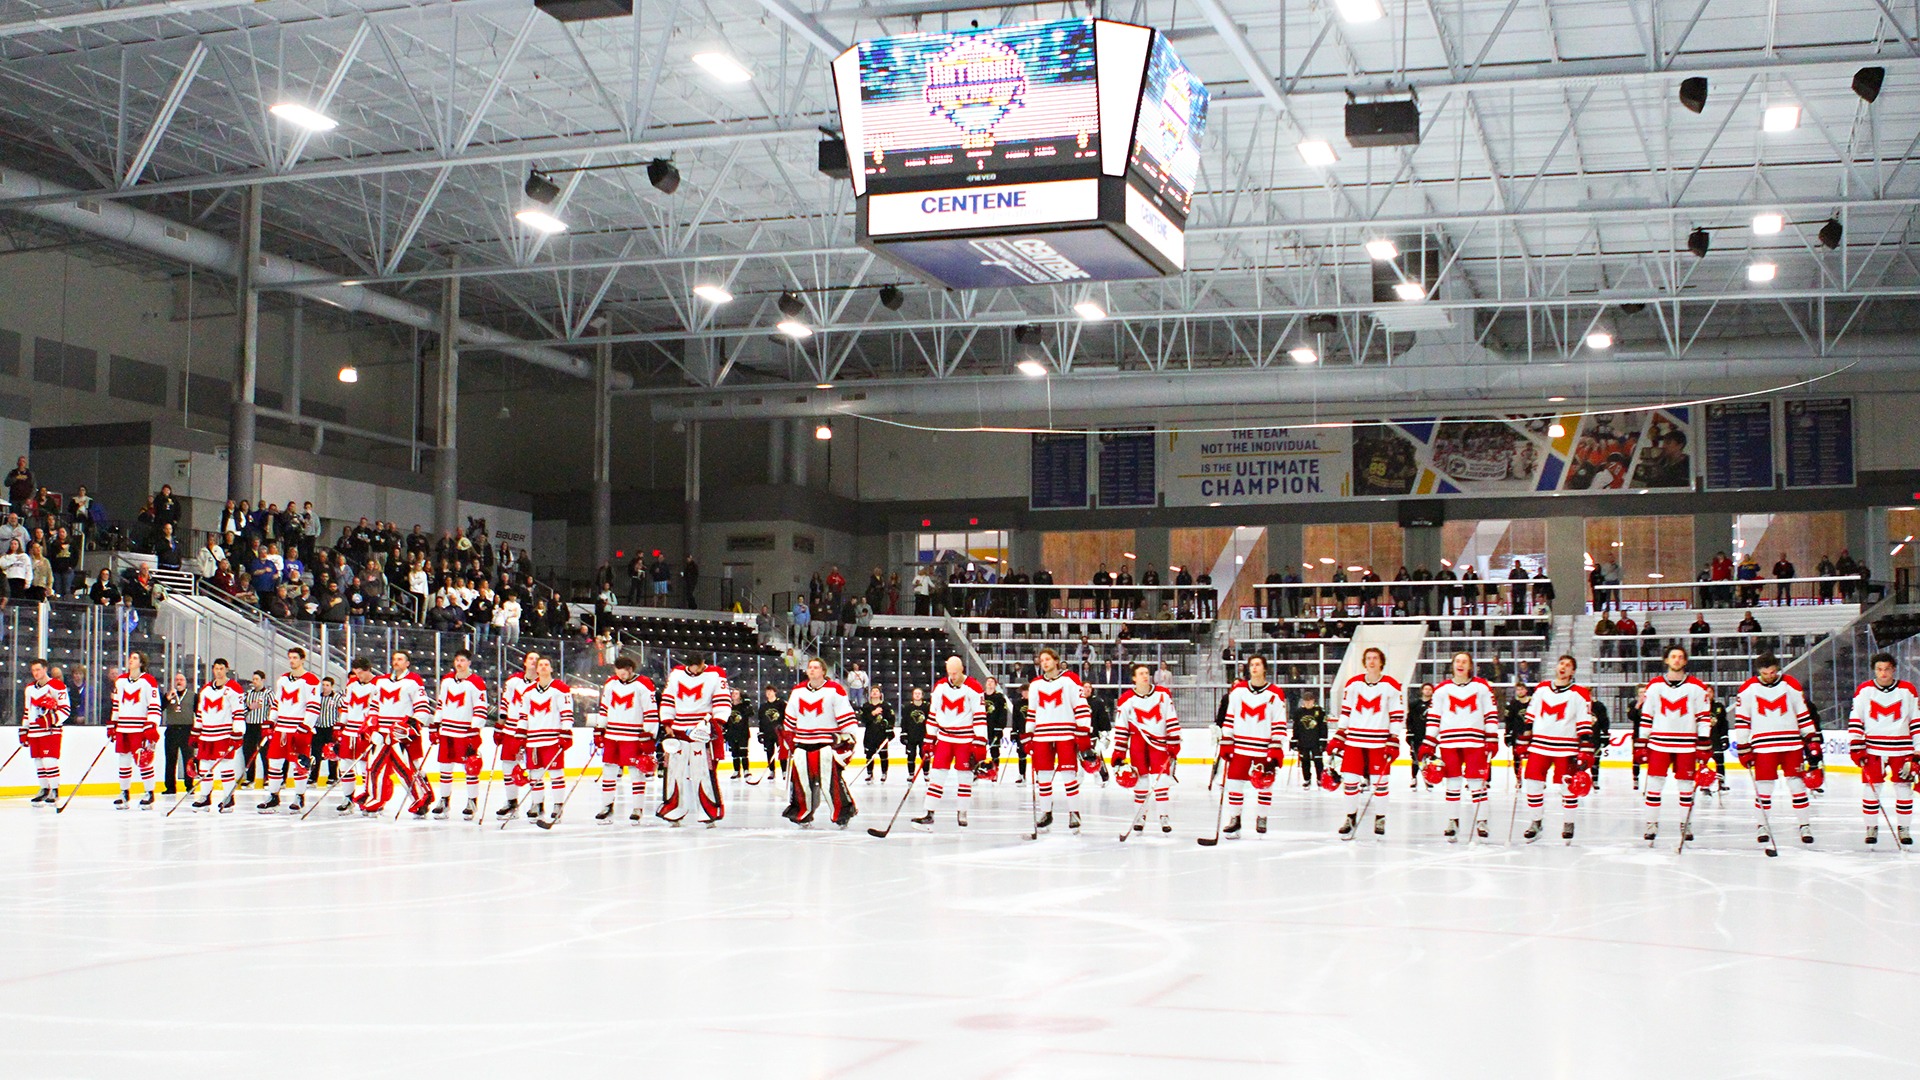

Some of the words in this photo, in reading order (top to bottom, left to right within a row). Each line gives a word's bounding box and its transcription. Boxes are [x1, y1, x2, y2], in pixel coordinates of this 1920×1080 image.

[921, 191, 1026, 214] CENTENE
[1232, 429, 1254, 439] THE
[1201, 443, 1224, 454] NOT
[1227, 442, 1248, 452] THE
[1201, 464, 1211, 473] IS
[1214, 463, 1232, 472] THE
[1236, 459, 1319, 476] ULTIMATE
[1201, 477, 1323, 496] CHAMPION.
[57, 692, 67, 700] 27
[311, 687, 316, 696] 4
[1159, 694, 1165, 703] A
